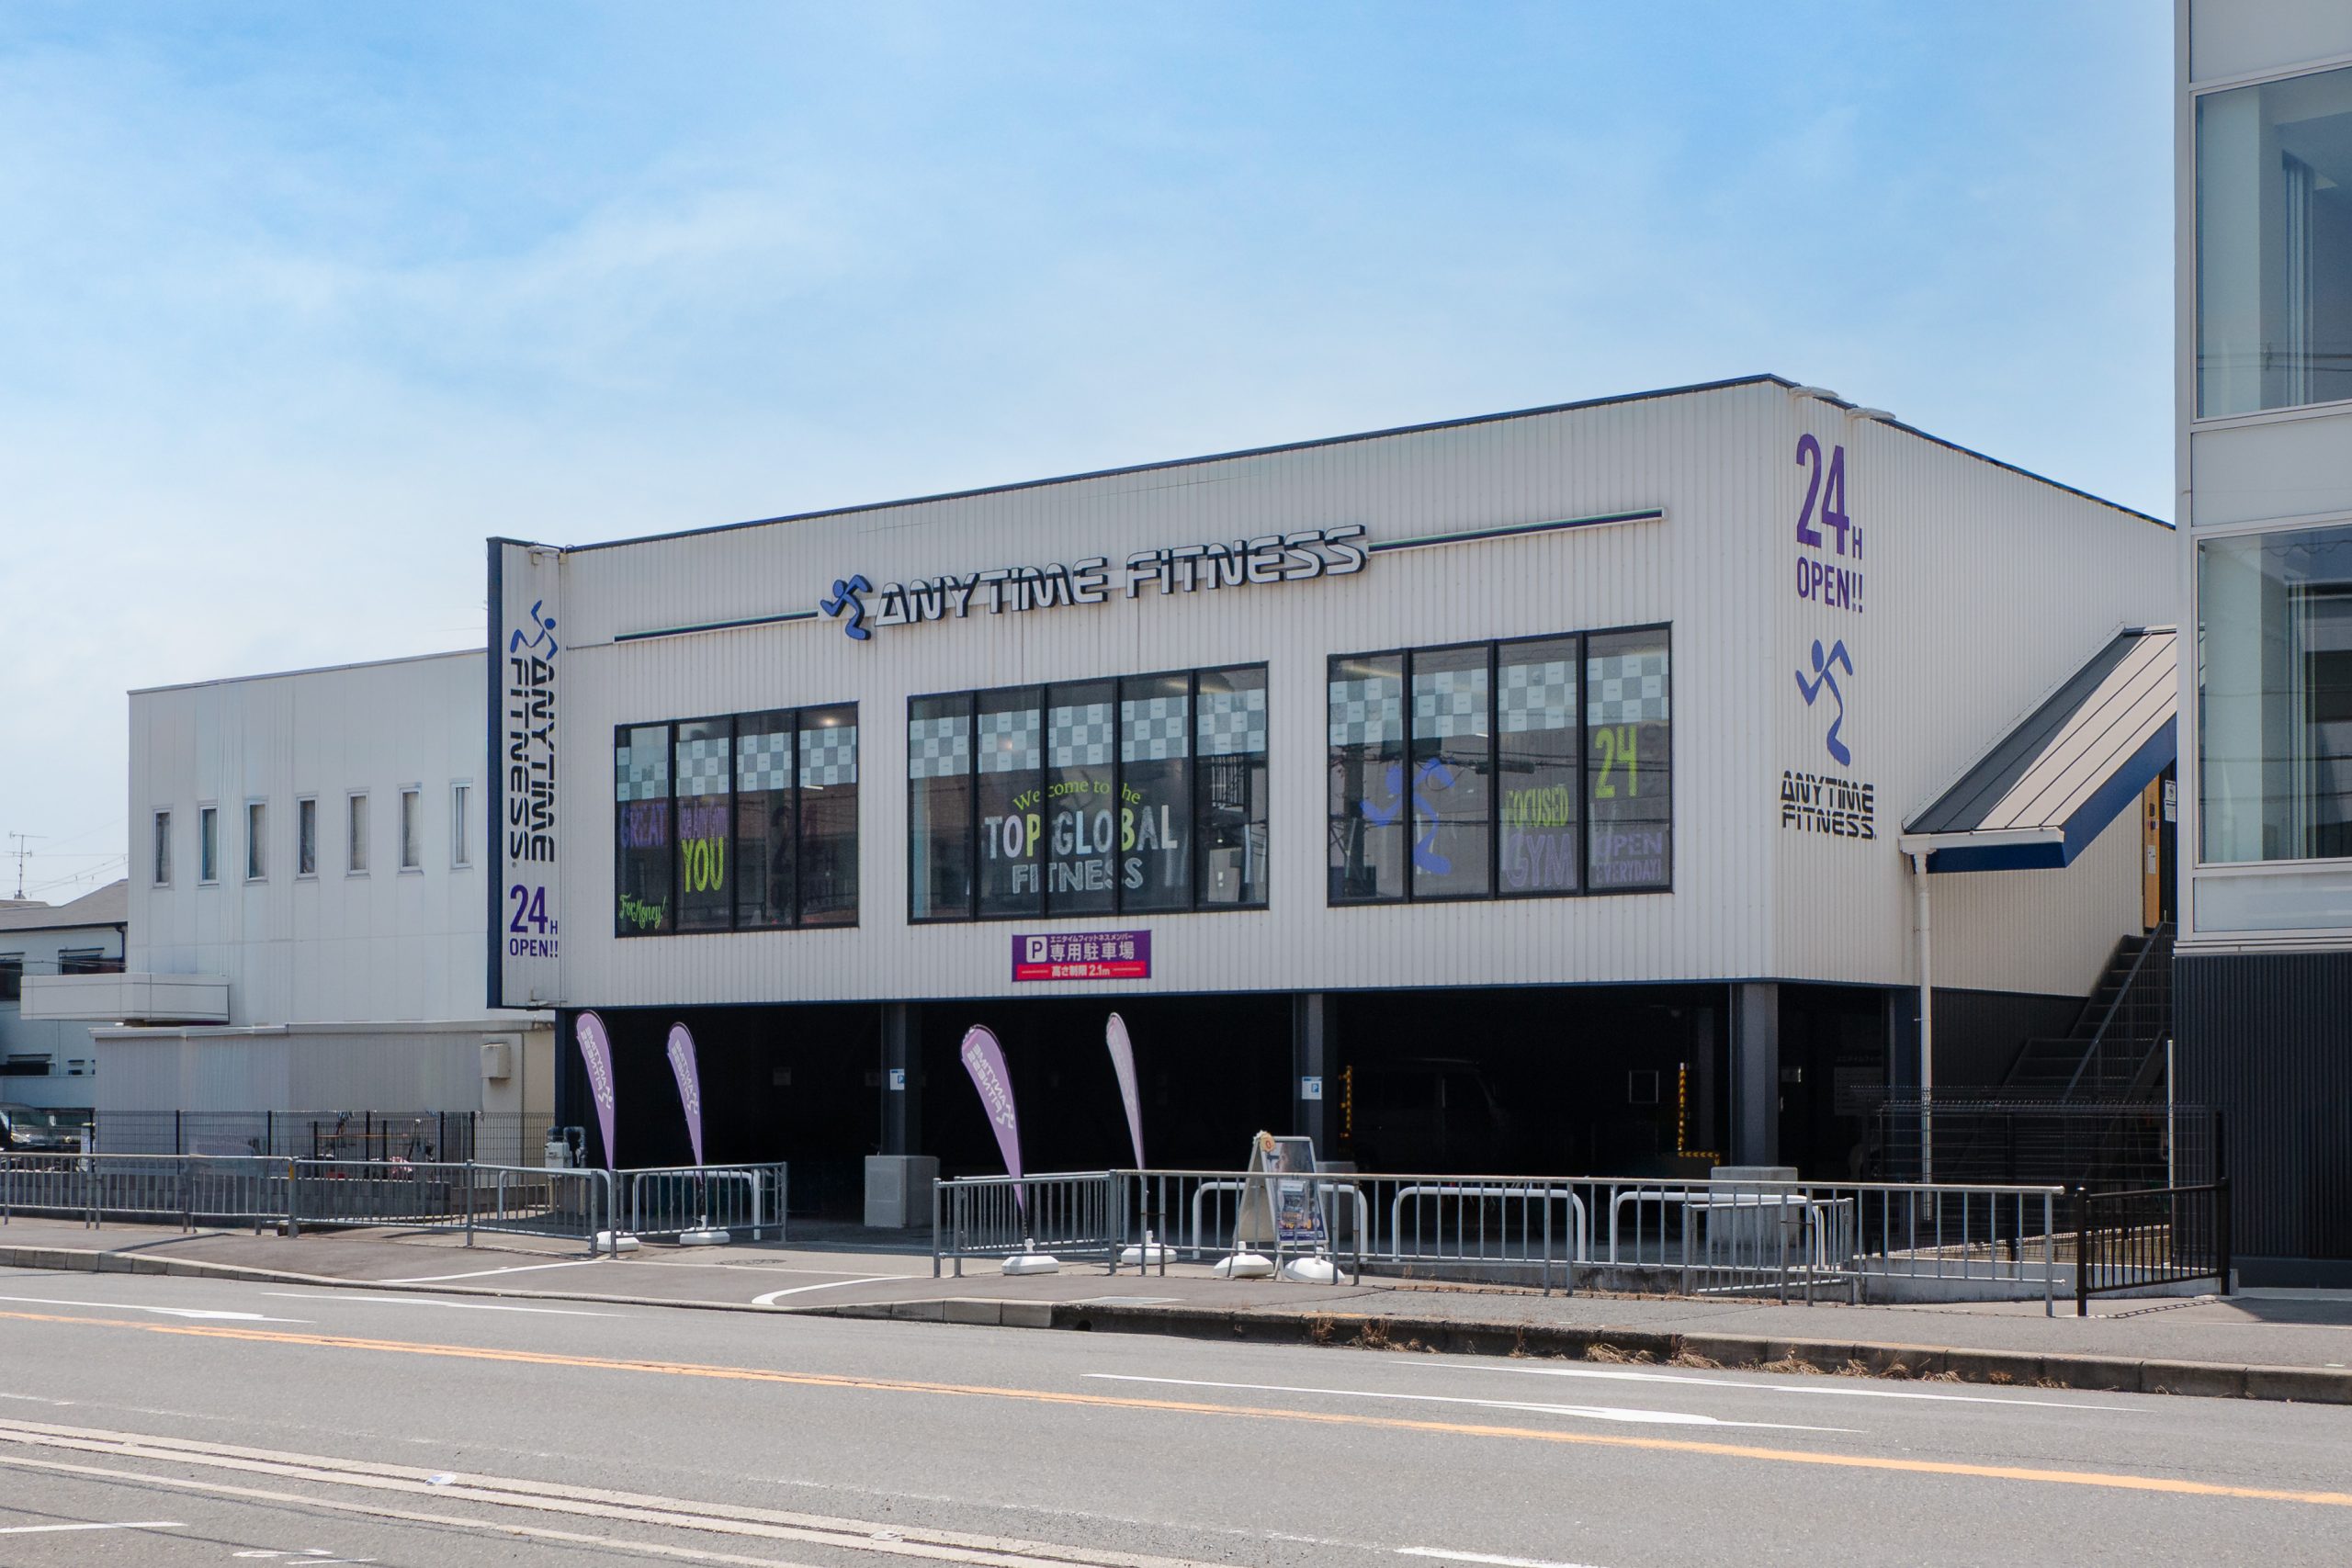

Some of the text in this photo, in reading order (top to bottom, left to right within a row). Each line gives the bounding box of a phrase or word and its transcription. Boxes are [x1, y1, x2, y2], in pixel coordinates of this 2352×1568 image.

[874, 524, 1366, 627] ANYTIME FITNESS
[1796, 556, 1863, 613] OPEN!!
[510, 657, 530, 862] FITNESS
[531, 655, 555, 863] ANYTIME
[1595, 725, 1637, 798] 24
[1012, 781, 1141, 811] Wecome to he
[1505, 784, 1569, 829] FOCUSED
[1781, 771, 1874, 814] ANYTIME
[984, 805, 1178, 860] TOP GLOBAL
[1596, 831, 1663, 857] OPEN
[1782, 804, 1875, 840] FITNESS
[681, 837, 724, 893] YOU
[1506, 832, 1575, 888] GYM
[1595, 858, 1662, 885] EVERYDAY!
[509, 937, 559, 958] OPEN!!
[1031, 940, 1044, 959] P
[1049, 942, 1136, 963] 専用駐車場
